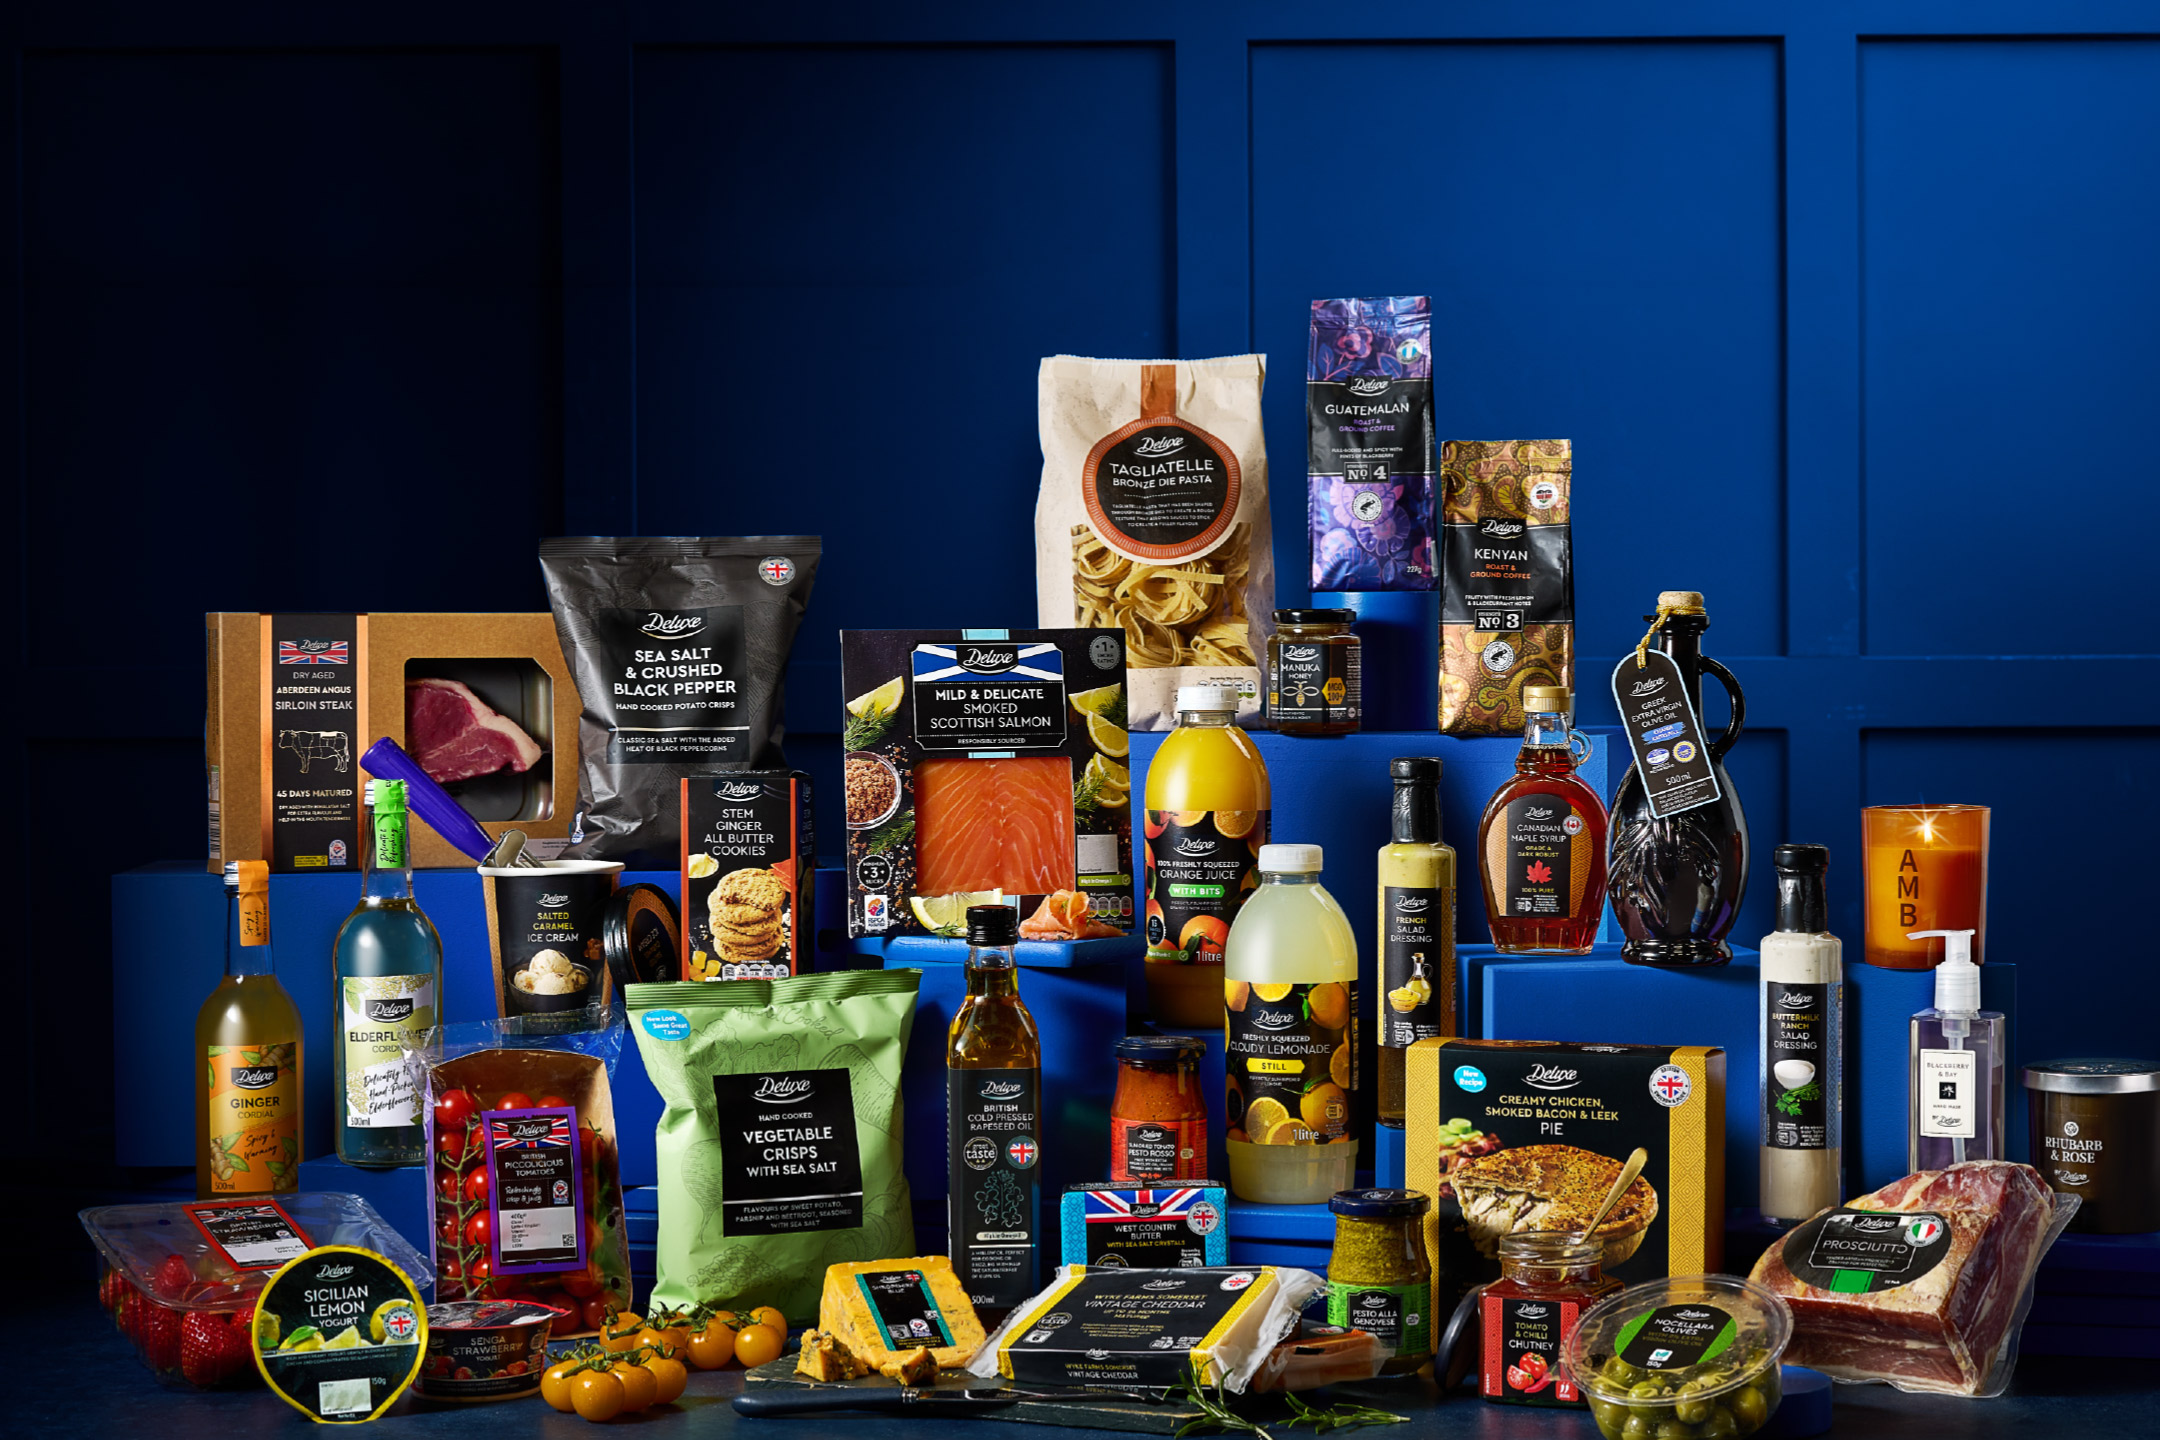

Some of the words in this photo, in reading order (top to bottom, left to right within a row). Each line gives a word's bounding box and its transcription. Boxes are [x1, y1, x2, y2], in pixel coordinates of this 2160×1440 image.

[1325, 403, 1409, 415] GUATEMALAN
[1109, 459, 1214, 477] TAGLIATELLE
[1112, 478, 1155, 489] BRONZE
[1159, 478, 1176, 487] DIE
[1179, 475, 1212, 484] PASTA
[1474, 548, 1528, 561] KENYAN
[642, 613, 701, 634] Deluxe
[635, 650, 666, 663] SEA
[671, 647, 711, 661] SALT
[963, 649, 1014, 667] Deluxe
[625, 667, 637, 679] &
[641, 664, 723, 679] CRUSHED
[1281, 664, 1321, 673] MANUKA
[276, 686, 320, 694] ABERDEEN
[322, 686, 352, 694] ANGUS
[614, 683, 669, 697] BLACK
[674, 681, 737, 695] PEPPER
[936, 690, 967, 701] MILD
[971, 689, 981, 700] &
[984, 688, 1044, 700] DELICATE
[275, 701, 317, 710] SIRLOIN
[319, 701, 353, 710] STEAK
[674, 702, 707, 710] POTATO
[708, 701, 735, 709] CRISPS
[1641, 696, 1666, 710] GREEK
[963, 703, 1018, 714] SMOKED
[930, 717, 995, 729] SCOTTISH
[998, 716, 1051, 728] SALMON
[718, 781, 760, 797] Deluxe
[722, 808, 754, 819] STEM
[716, 821, 762, 831] GINGER
[1517, 824, 1561, 832] CANADIAN
[704, 834, 726, 844] ALL
[728, 833, 774, 844] BUTTER
[1511, 835, 1538, 843] MAPLE
[1540, 835, 1567, 843] SYRUP
[712, 846, 766, 856] COOKIES
[1203, 861, 1240, 869] SQUEEZED
[1160, 869, 1203, 880] ORANGE
[1205, 870, 1236, 880] JUICE
[1172, 887, 1196, 895] WITH
[1199, 887, 1221, 895] BITS
[537, 912, 570, 920] SALTED
[1395, 916, 1427, 924] FRENCH
[533, 922, 574, 930] CARAMEL
[1397, 925, 1426, 934] SALAD
[527, 934, 543, 942] ICE
[546, 933, 579, 942] CREAM
[1390, 934, 1433, 943] DRESSING
[370, 1003, 410, 1017] Deluxe
[1772, 1013, 1820, 1021] BUTTERMILK
[1780, 1022, 1810, 1030] RANCH
[1780, 1031, 1810, 1040] SALAD
[1229, 1041, 1264, 1053] CLOUDY
[1267, 1044, 1331, 1055] LEMONADE
[1774, 1041, 1818, 1050] DRESSING
[1261, 1062, 1287, 1071] STILL
[1926, 1062, 1970, 1070] BLACKBERRY
[1526, 1064, 1578, 1083] Deluxe
[754, 1076, 811, 1097] Deluxe
[230, 1096, 280, 1109] GINGER
[1499, 1095, 1546, 1106] CREAMY
[1548, 1097, 1605, 1110] CHICKEN,
[983, 1104, 1019, 1113] BRITISH
[1485, 1106, 1533, 1118] SMOKED
[1536, 1108, 1577, 1119] BACON
[1580, 1109, 1588, 1120] &
[1590, 1110, 1619, 1121] LEEK
[237, 1110, 275, 1120] CORDIAL
[759, 1113, 780, 1122] HAND
[782, 1112, 813, 1120] COOKED
[967, 1113, 993, 1122] COLD
[995, 1113, 1034, 1122] PRESSED
[969, 1122, 1016, 1131] RAPESEED
[1017, 1122, 1032, 1131] OIL
[1540, 1122, 1563, 1136] PIE
[743, 1126, 833, 1144] VEGETABLE
[2045, 1136, 2103, 1152] RHUBARB
[763, 1146, 818, 1161] CRISPS
[1128, 1149, 1149, 1157] PESTO
[1150, 1150, 1175, 1158] ROSSO
[505, 1159, 564, 1169] PICCOLICIOUS
[515, 1168, 556, 1177] TOMATOES
[746, 1166, 780, 1178] WITH
[782, 1163, 806, 1175] SEA
[809, 1161, 837, 1174] SALT
[819, 1208, 852, 1217] SEASONED
[212, 1222, 285, 1234] STRAWBERRIES
[1114, 1224, 1137, 1233] WEST
[1138, 1223, 1177, 1232] COUNTRY
[1130, 1232, 1162, 1240] BUTTER
[1822, 1239, 1908, 1254] PROSCIUTTO
[304, 1285, 369, 1303] SICILIAN
[310, 1301, 366, 1318] LEMON
[1085, 1300, 1140, 1308] VINTAGE
[1142, 1300, 1206, 1309] CHEDDAR
[318, 1317, 358, 1328] YOGURT
[1353, 1317, 1396, 1326] GENOVESE
[1515, 1322, 1549, 1331] TOMATO
[1654, 1318, 1715, 1331] NOCELLARA
[1515, 1330, 1521, 1338] &
[1522, 1331, 1548, 1340] CHILLI
[1662, 1326, 1699, 1336] OLIVES
[470, 1335, 506, 1346] SENGA
[1508, 1339, 1554, 1351] CHUTNEY
[452, 1342, 523, 1356] STRAWBERRY
[476, 1354, 501, 1362] YOGURT
[1067, 1370, 1100, 1379] VINTAGE
[1102, 1371, 1139, 1379] CHEDDAR
